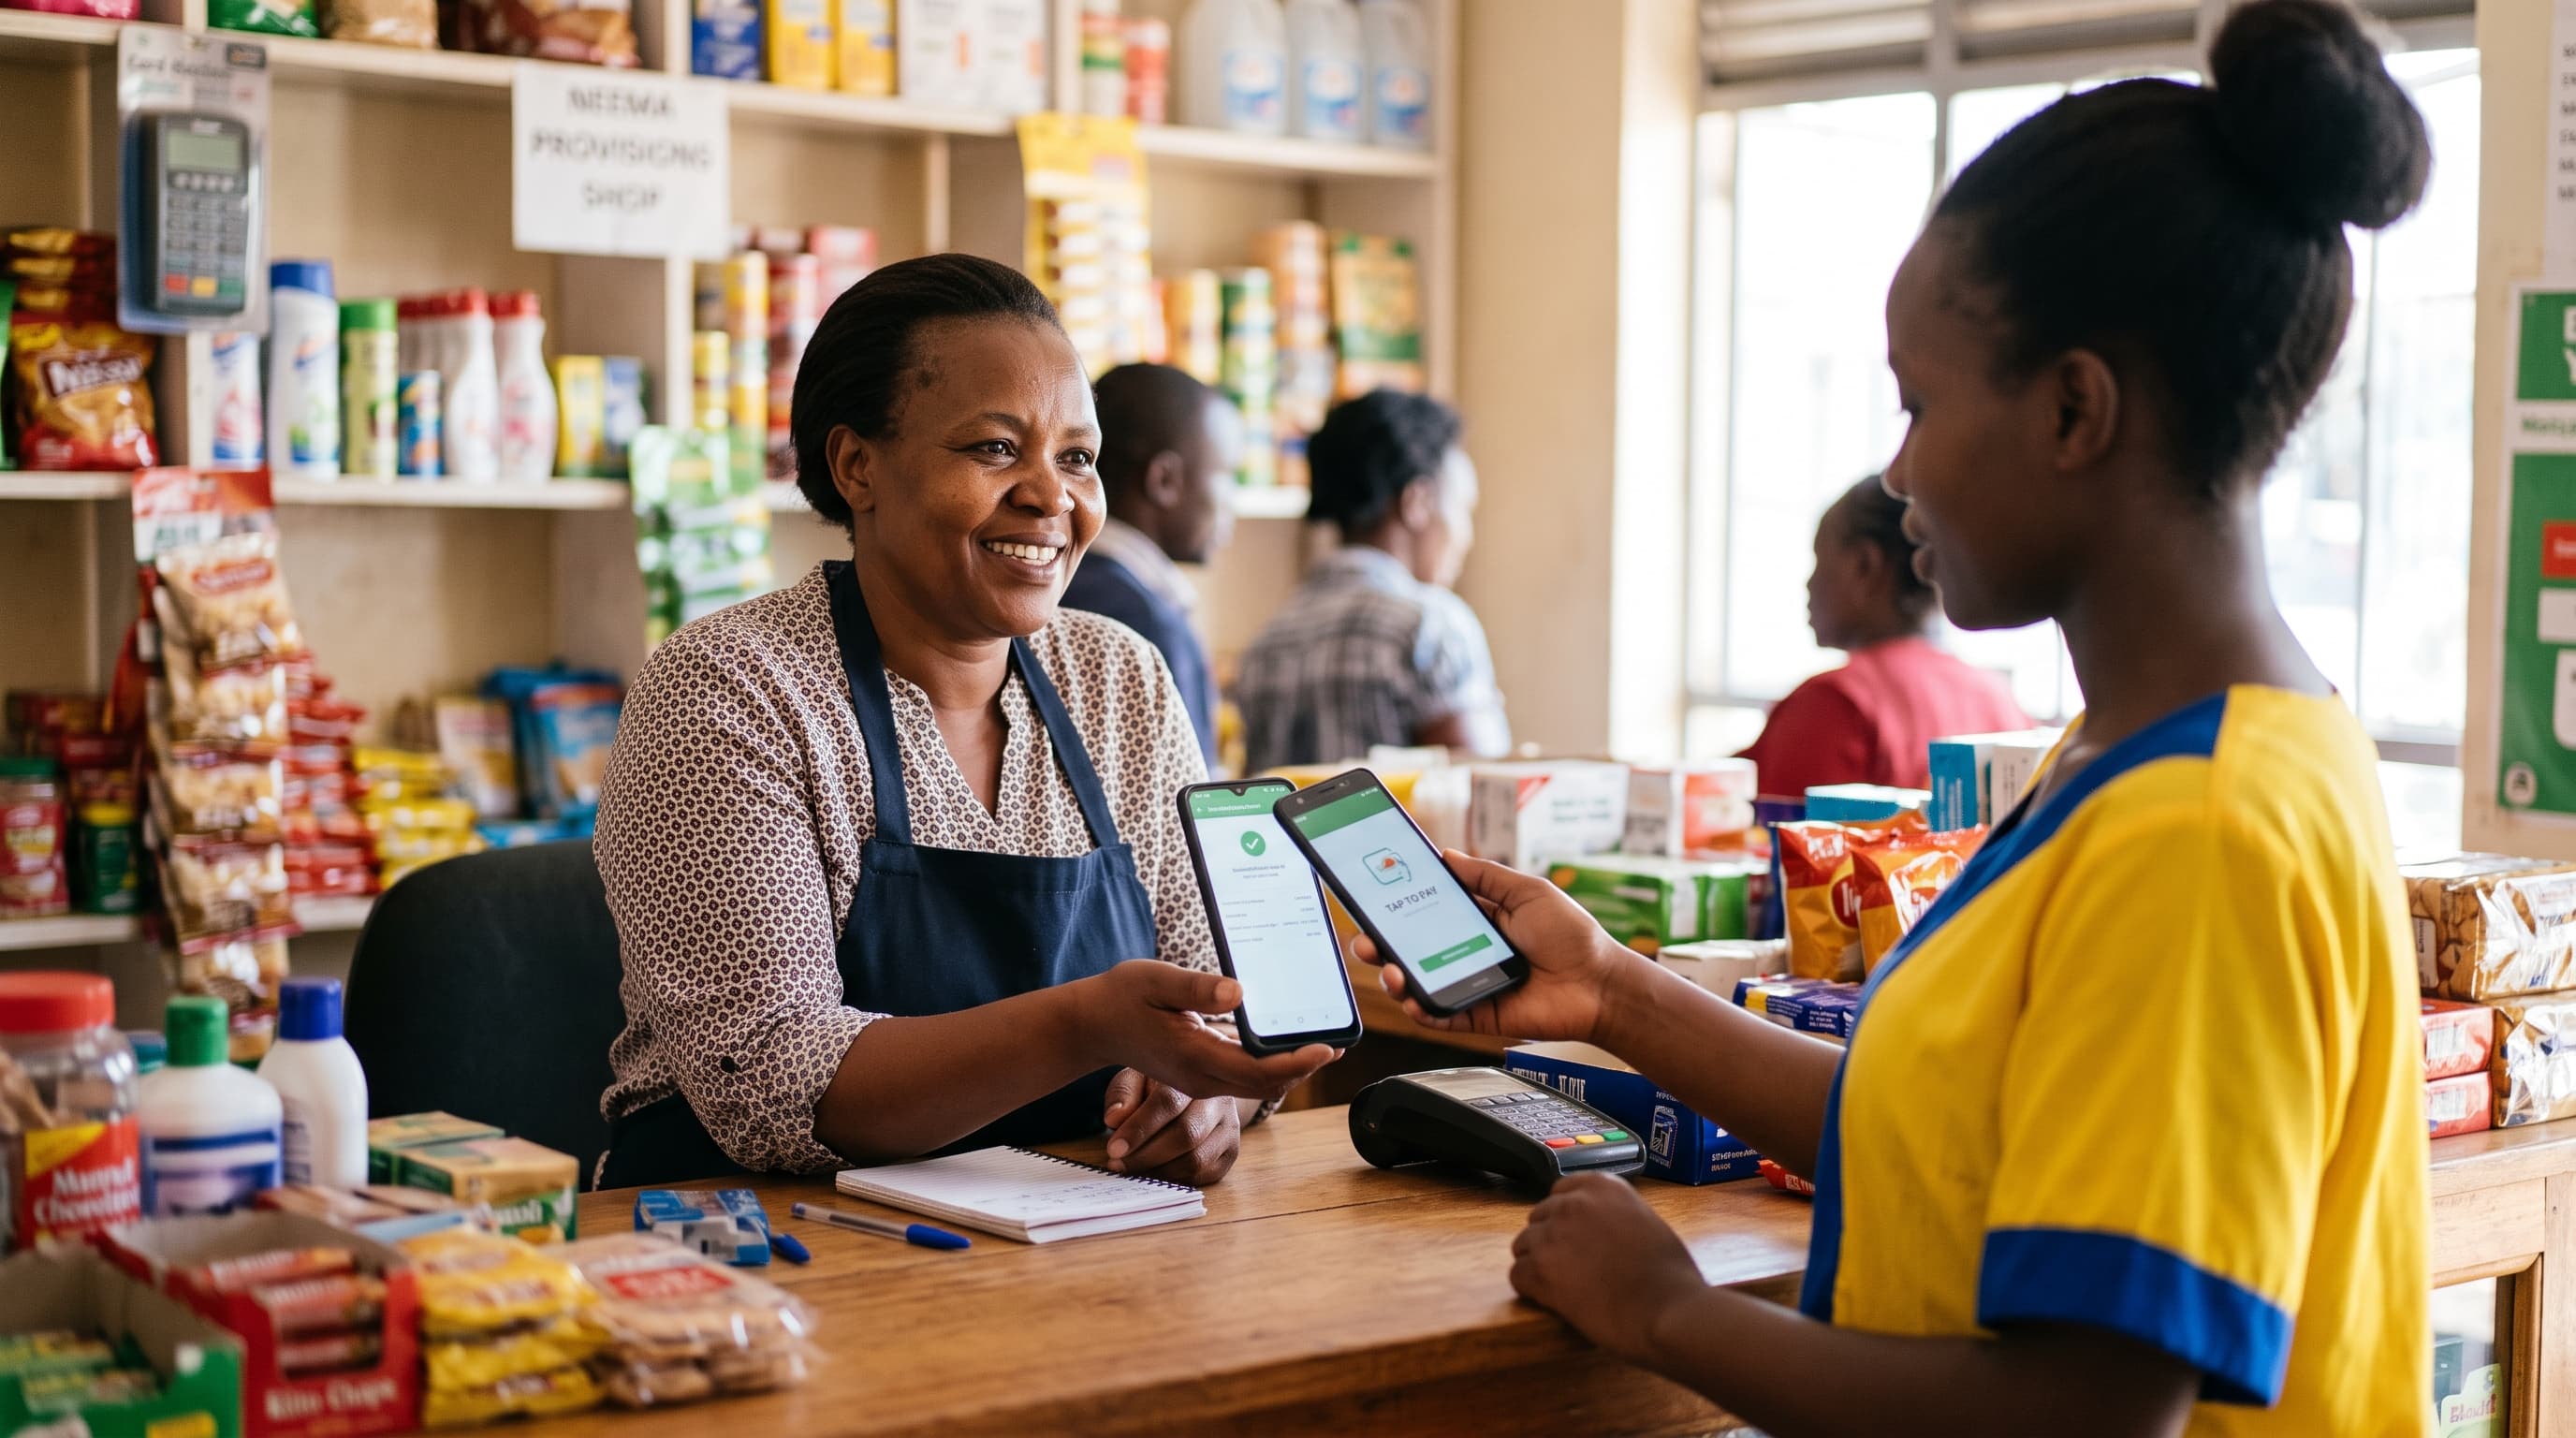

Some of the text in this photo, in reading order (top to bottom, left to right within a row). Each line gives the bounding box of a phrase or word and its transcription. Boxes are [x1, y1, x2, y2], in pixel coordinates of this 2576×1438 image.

[568, 87, 674, 117] NEEMA
[531, 128, 712, 171] PROVISIONS
[582, 181, 662, 213] SHOP
[1385, 899, 1404, 913] TAP
[1404, 893, 1419, 905] TO
[1418, 886, 1439, 900] PAY
